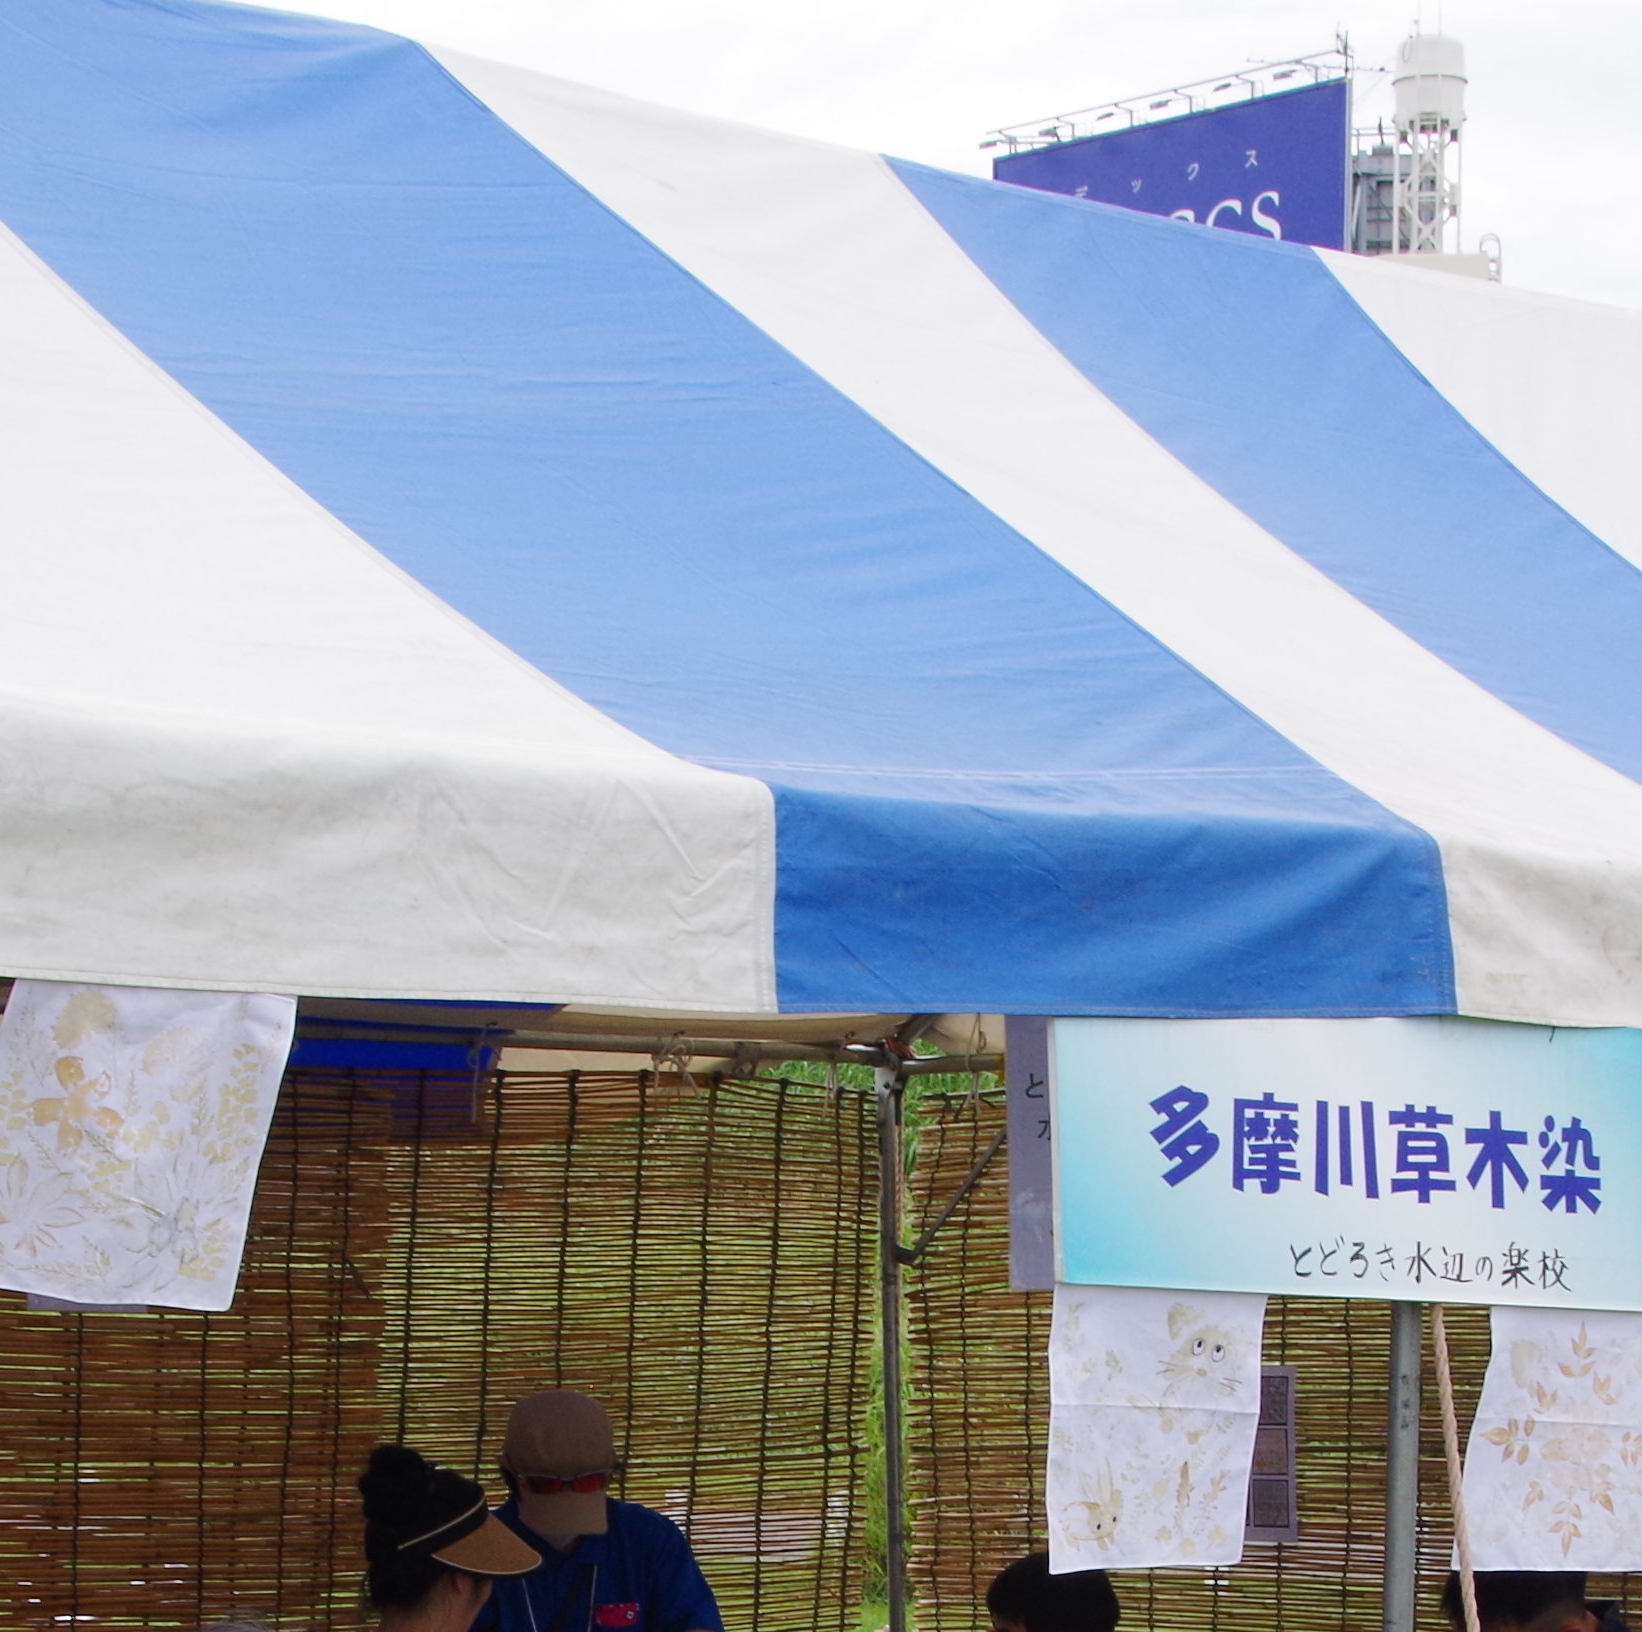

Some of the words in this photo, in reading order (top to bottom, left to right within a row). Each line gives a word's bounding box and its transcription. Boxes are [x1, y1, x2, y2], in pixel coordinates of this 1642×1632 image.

[1148, 1085, 1602, 1214] 多摩川草木染
[1289, 1234, 1574, 1293] とどろき水辺の楽校
